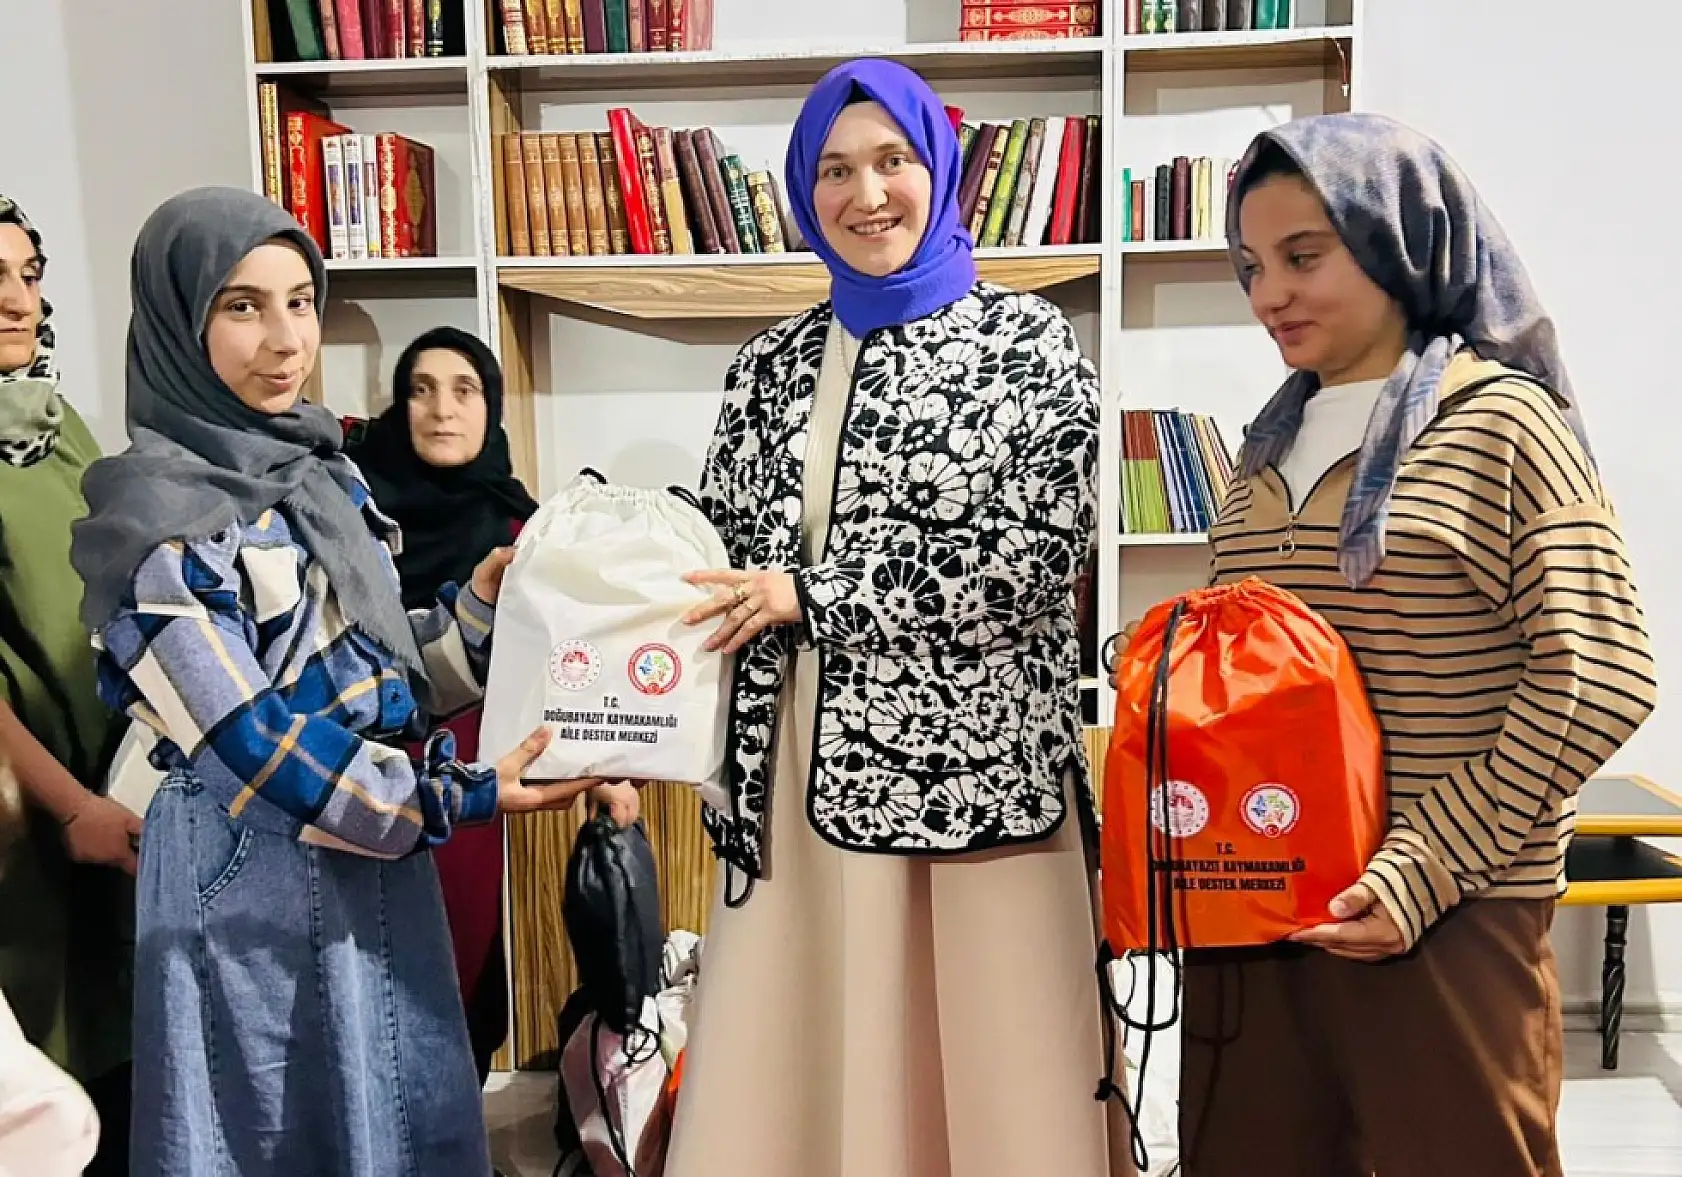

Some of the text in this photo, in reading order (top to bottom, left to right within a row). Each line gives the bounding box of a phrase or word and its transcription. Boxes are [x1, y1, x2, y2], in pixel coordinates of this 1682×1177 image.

[603, 696, 620, 709] T.C.
[543, 708, 678, 728] DOĞUBAYAZIT KAYMAKAMLIĞI
[560, 726, 658, 744] AİLE DESTEK MERKEZİ
[1215, 841, 1237, 855] T.C.
